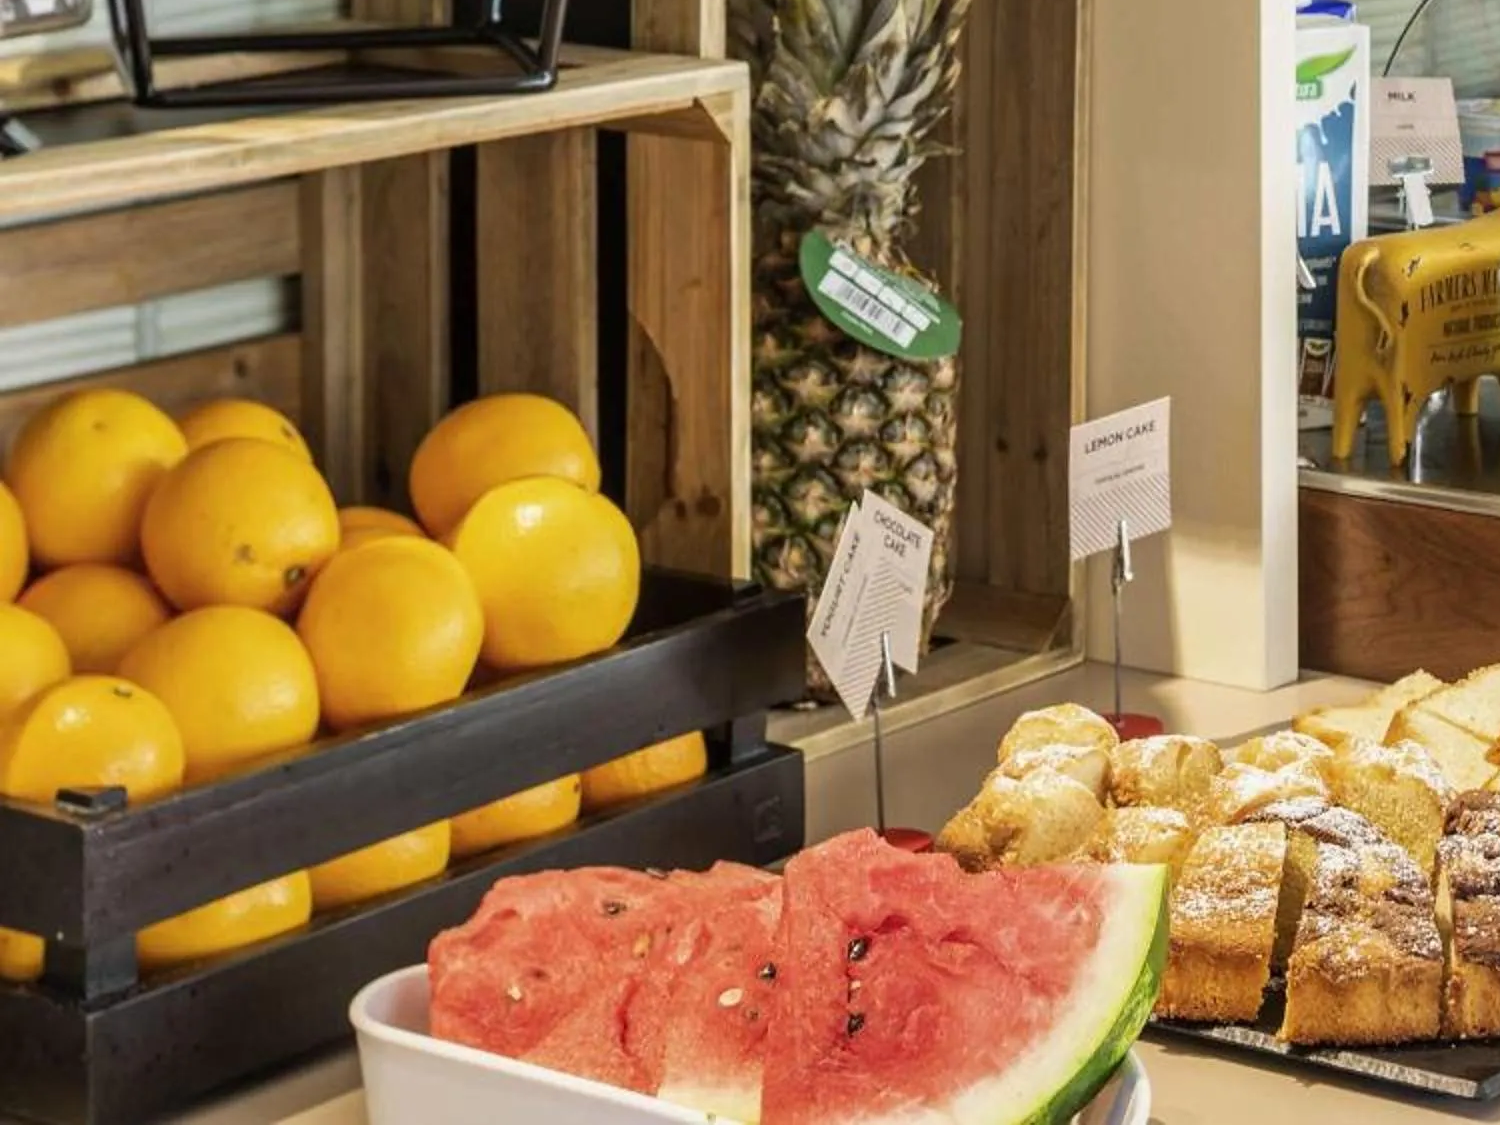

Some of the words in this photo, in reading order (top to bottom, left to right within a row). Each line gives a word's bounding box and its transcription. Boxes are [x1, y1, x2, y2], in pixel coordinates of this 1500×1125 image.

[1388, 91, 1416, 102] MILK
[1084, 432, 1123, 454] LEMON
[1126, 420, 1156, 440] CAKE
[874, 510, 922, 550] CHOCOLATE
[884, 534, 906, 557] CAKE
